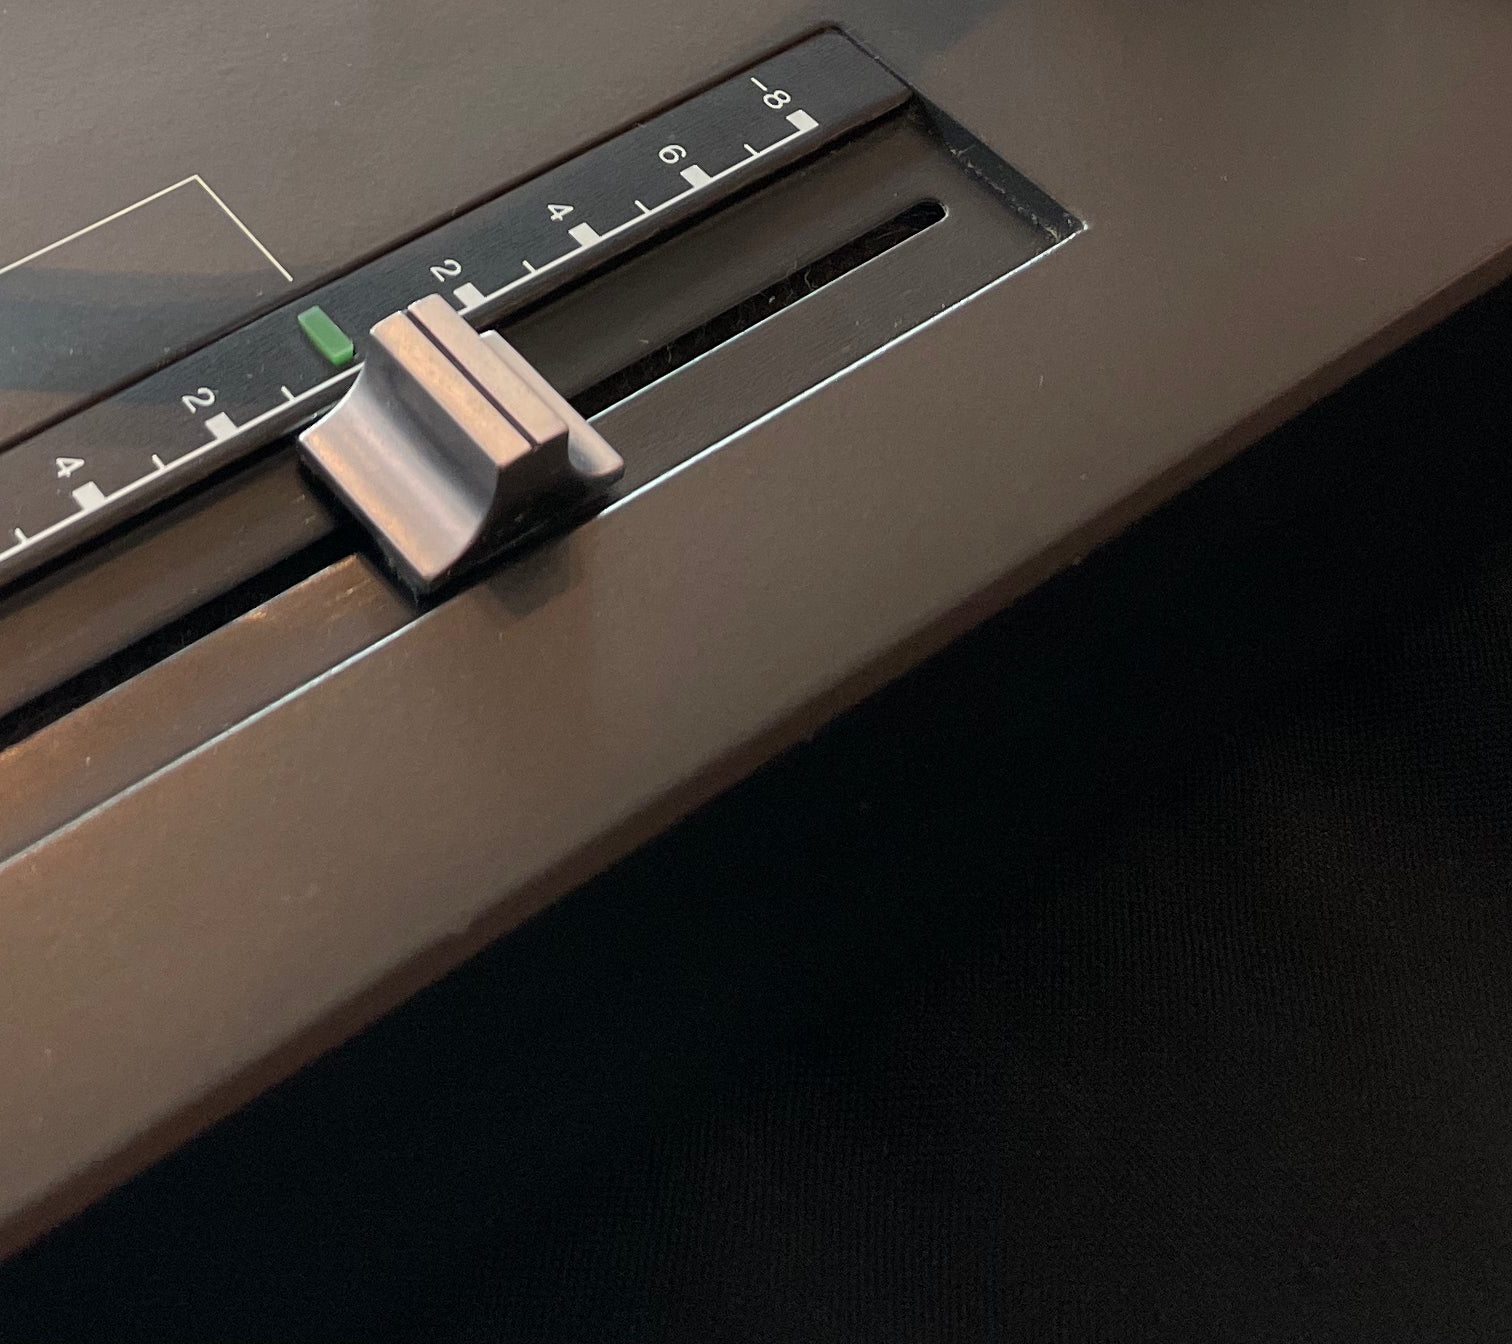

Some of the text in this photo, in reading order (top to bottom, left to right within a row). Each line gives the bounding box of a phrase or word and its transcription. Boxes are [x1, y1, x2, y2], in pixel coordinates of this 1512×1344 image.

[750, 77, 792, 110] -8
[658, 144, 687, 164] 6
[547, 204, 574, 222] 4
[429, 258, 462, 283] 2
[181, 386, 215, 414] 2
[55, 457, 85, 478] 4
